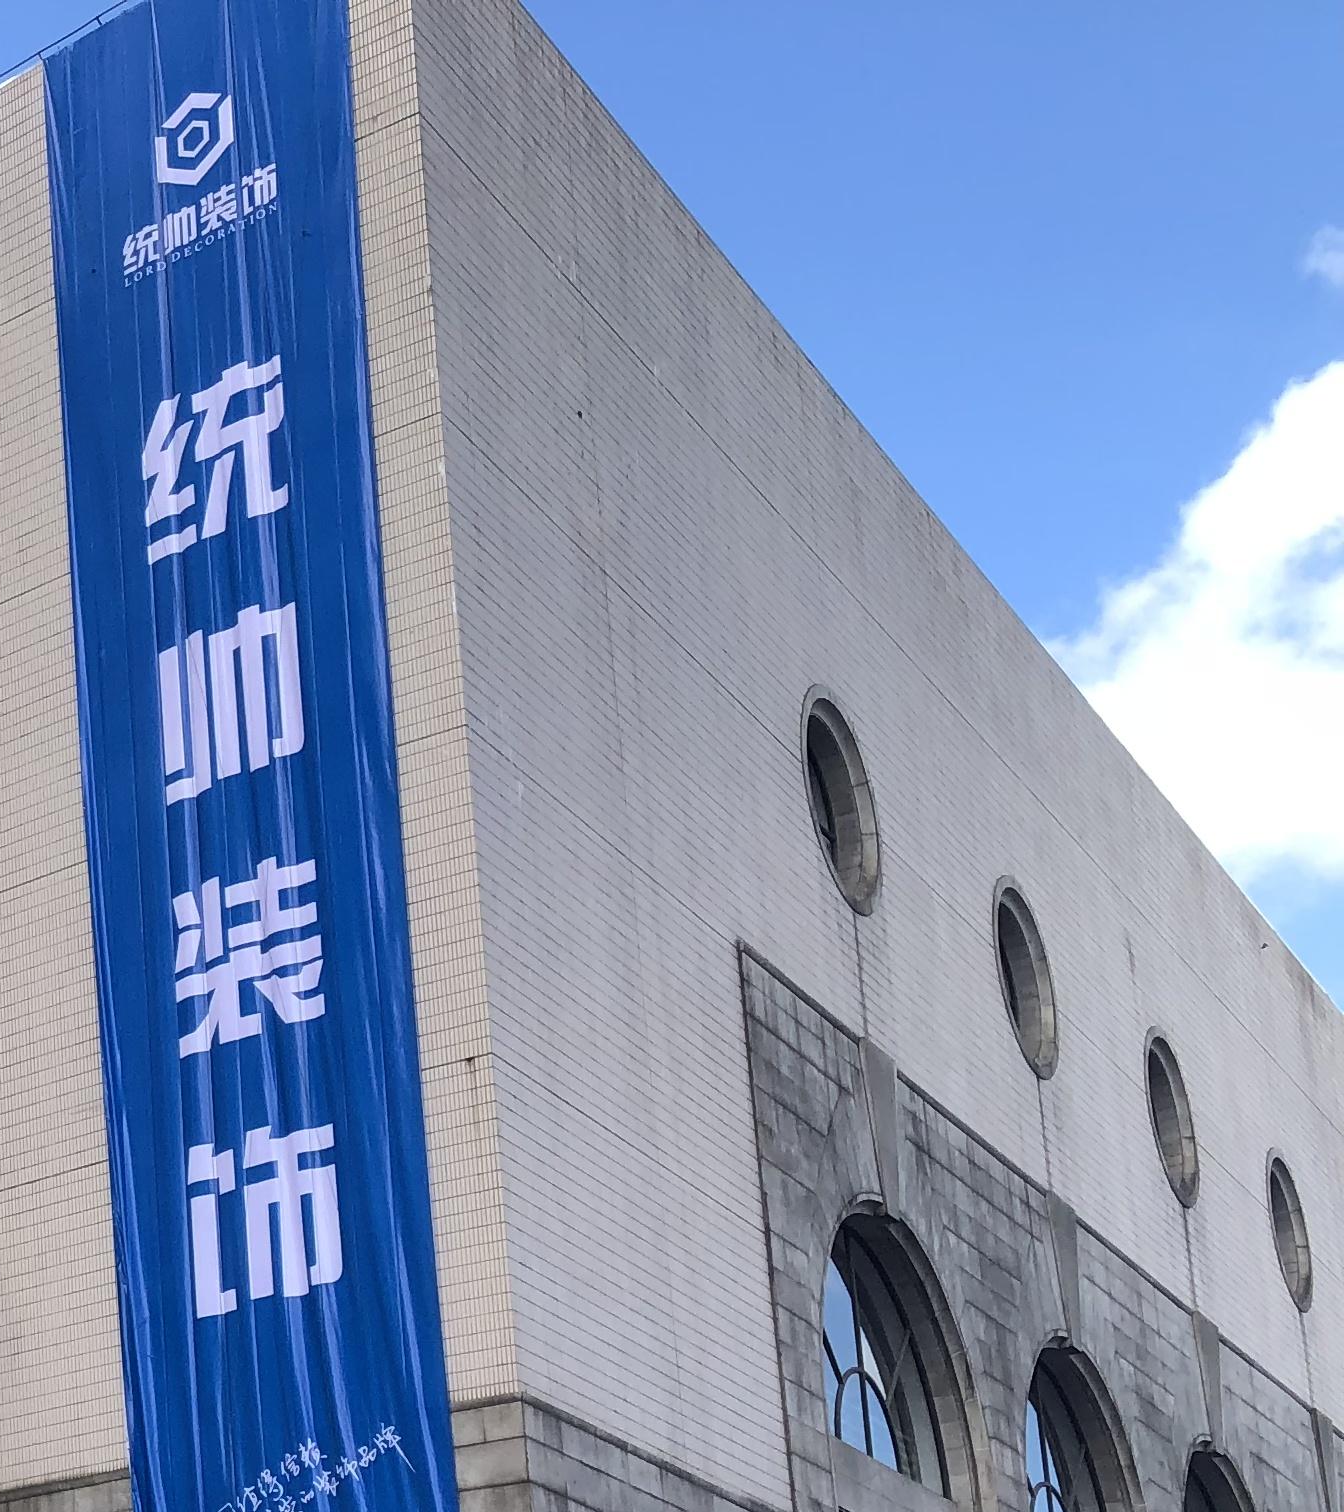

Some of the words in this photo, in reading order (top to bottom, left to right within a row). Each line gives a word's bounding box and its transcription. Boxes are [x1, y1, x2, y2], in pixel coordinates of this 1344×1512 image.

[122, 163, 277, 275] 统帅装饰
[124, 261, 166, 288] LORD
[172, 202, 278, 263] DECORATION
[142, 354, 341, 1319] 统帅装饰
